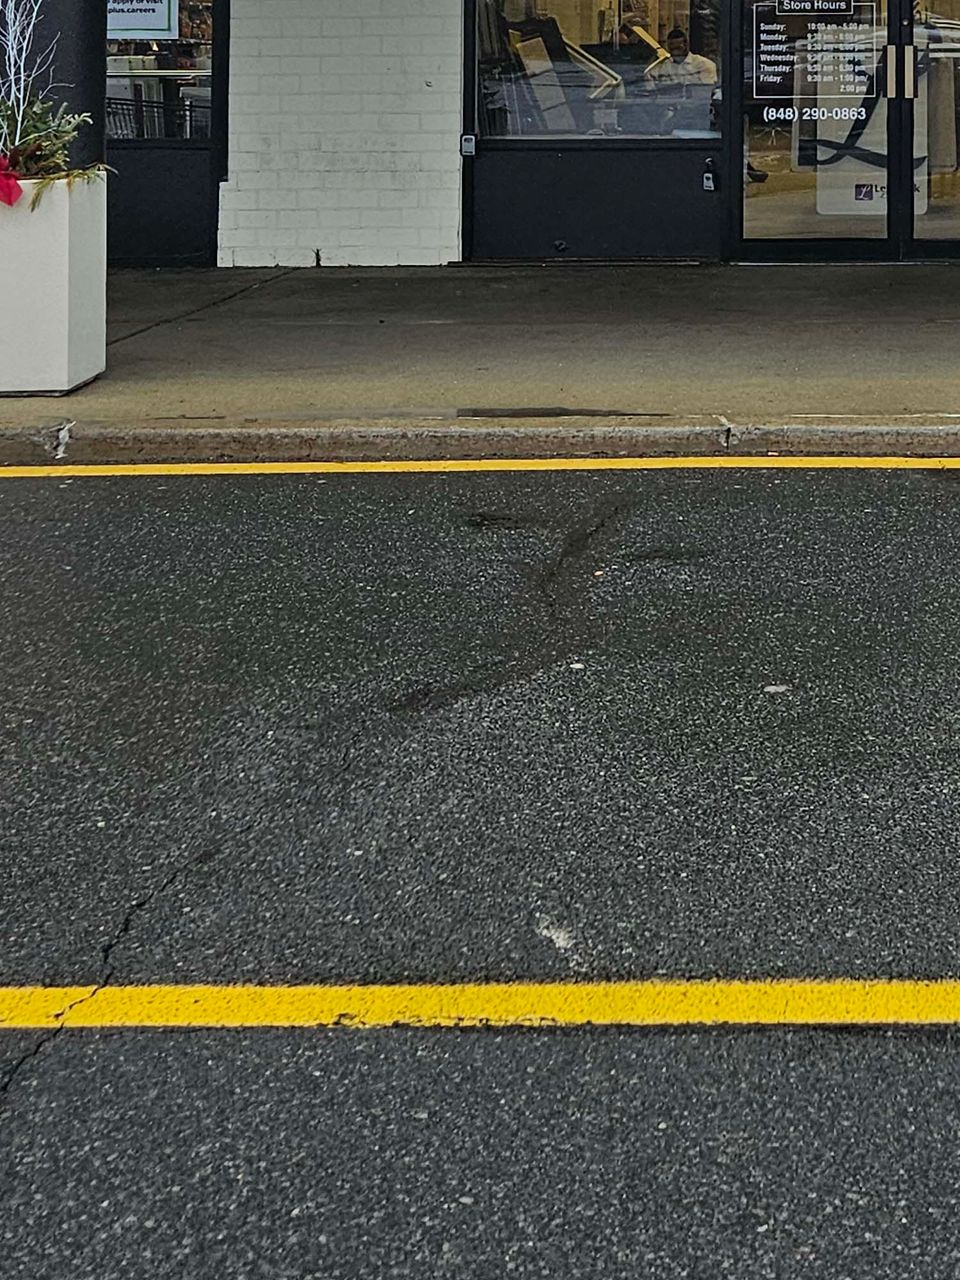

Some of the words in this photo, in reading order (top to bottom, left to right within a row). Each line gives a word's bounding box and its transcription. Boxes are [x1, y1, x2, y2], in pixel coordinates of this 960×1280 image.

[782, 0, 812, 10] Store
[814, 0, 847, 10] Hours
[763, 106, 799, 122] (848)
[802, 107, 867, 120] 290-0863
